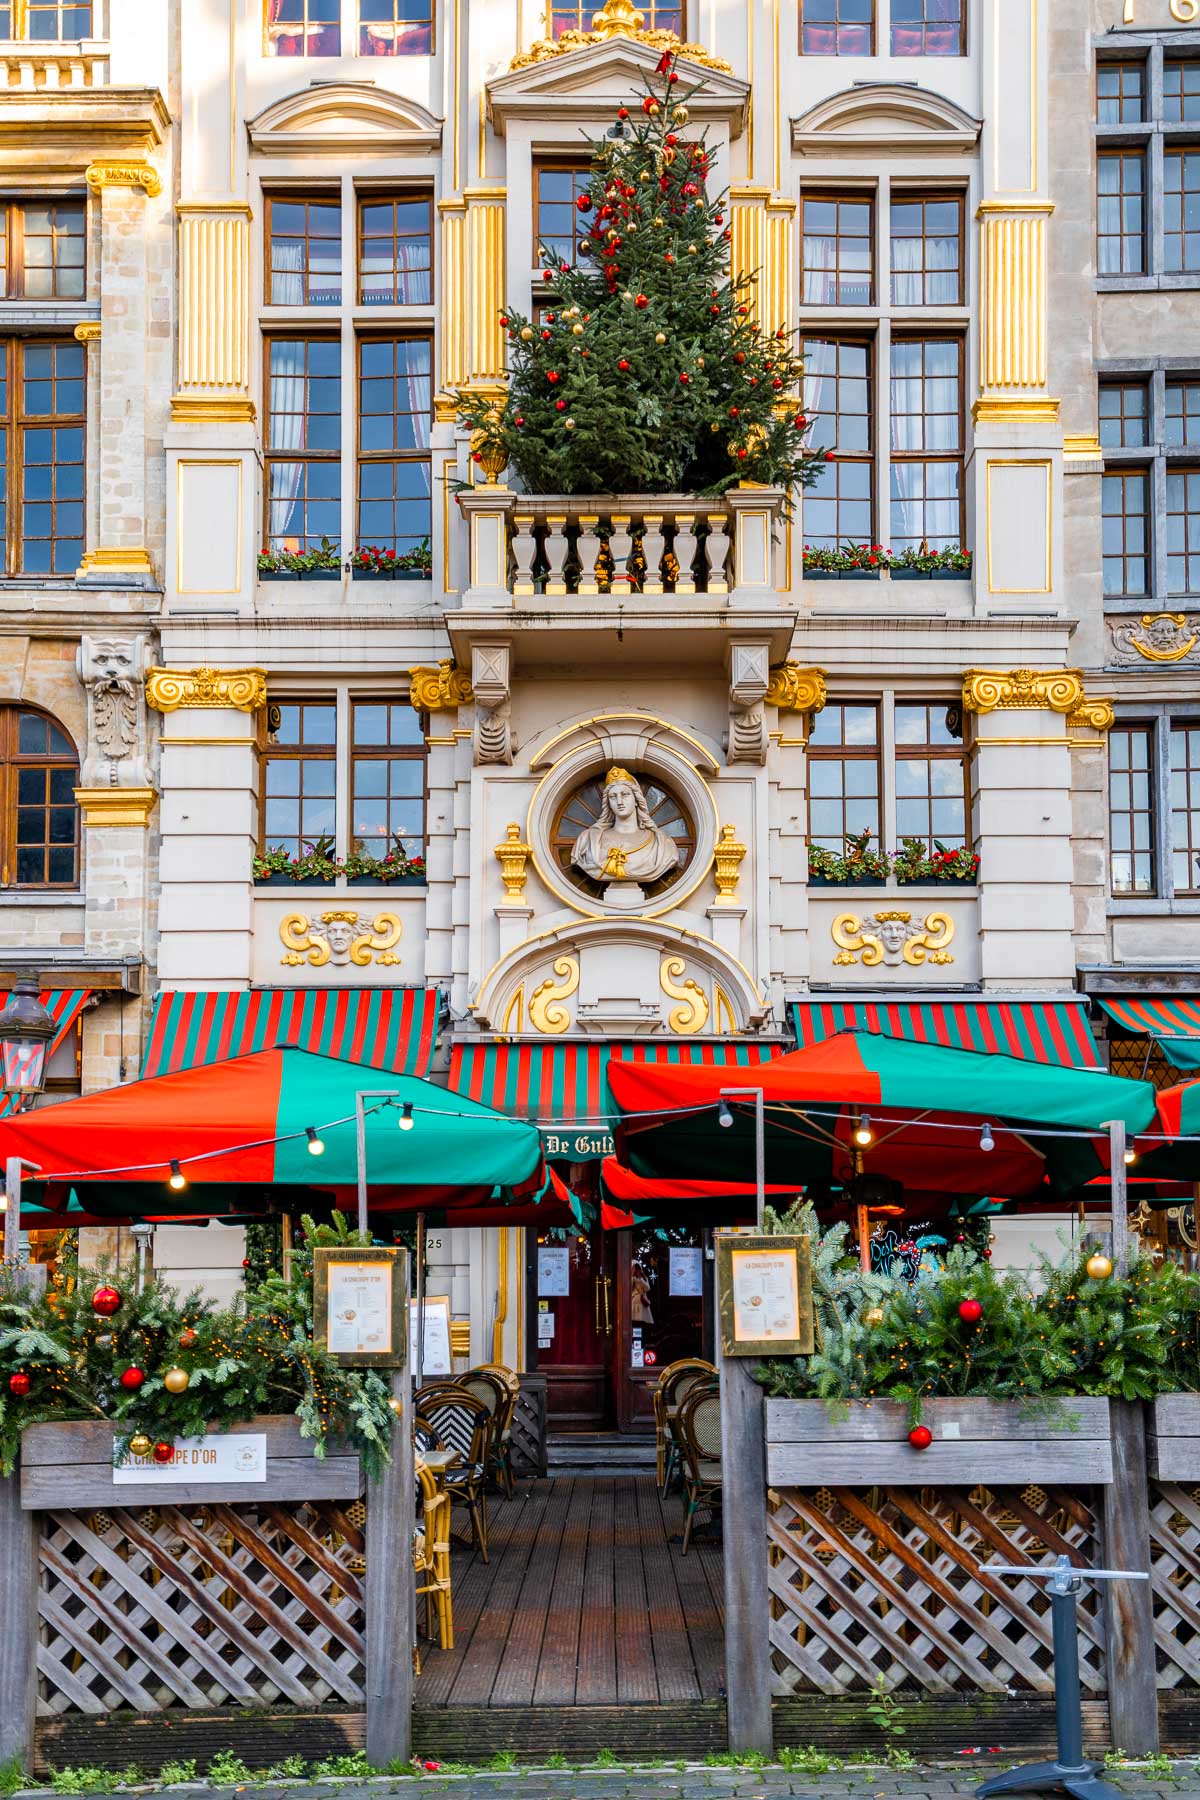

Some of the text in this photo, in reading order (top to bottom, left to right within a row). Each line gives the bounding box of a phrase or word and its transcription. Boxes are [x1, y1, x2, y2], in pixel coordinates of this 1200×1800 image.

[547, 1136, 569, 1153] De
[427, 1239, 442, 1249] 25
[191, 1448, 217, 1464] D'OR
